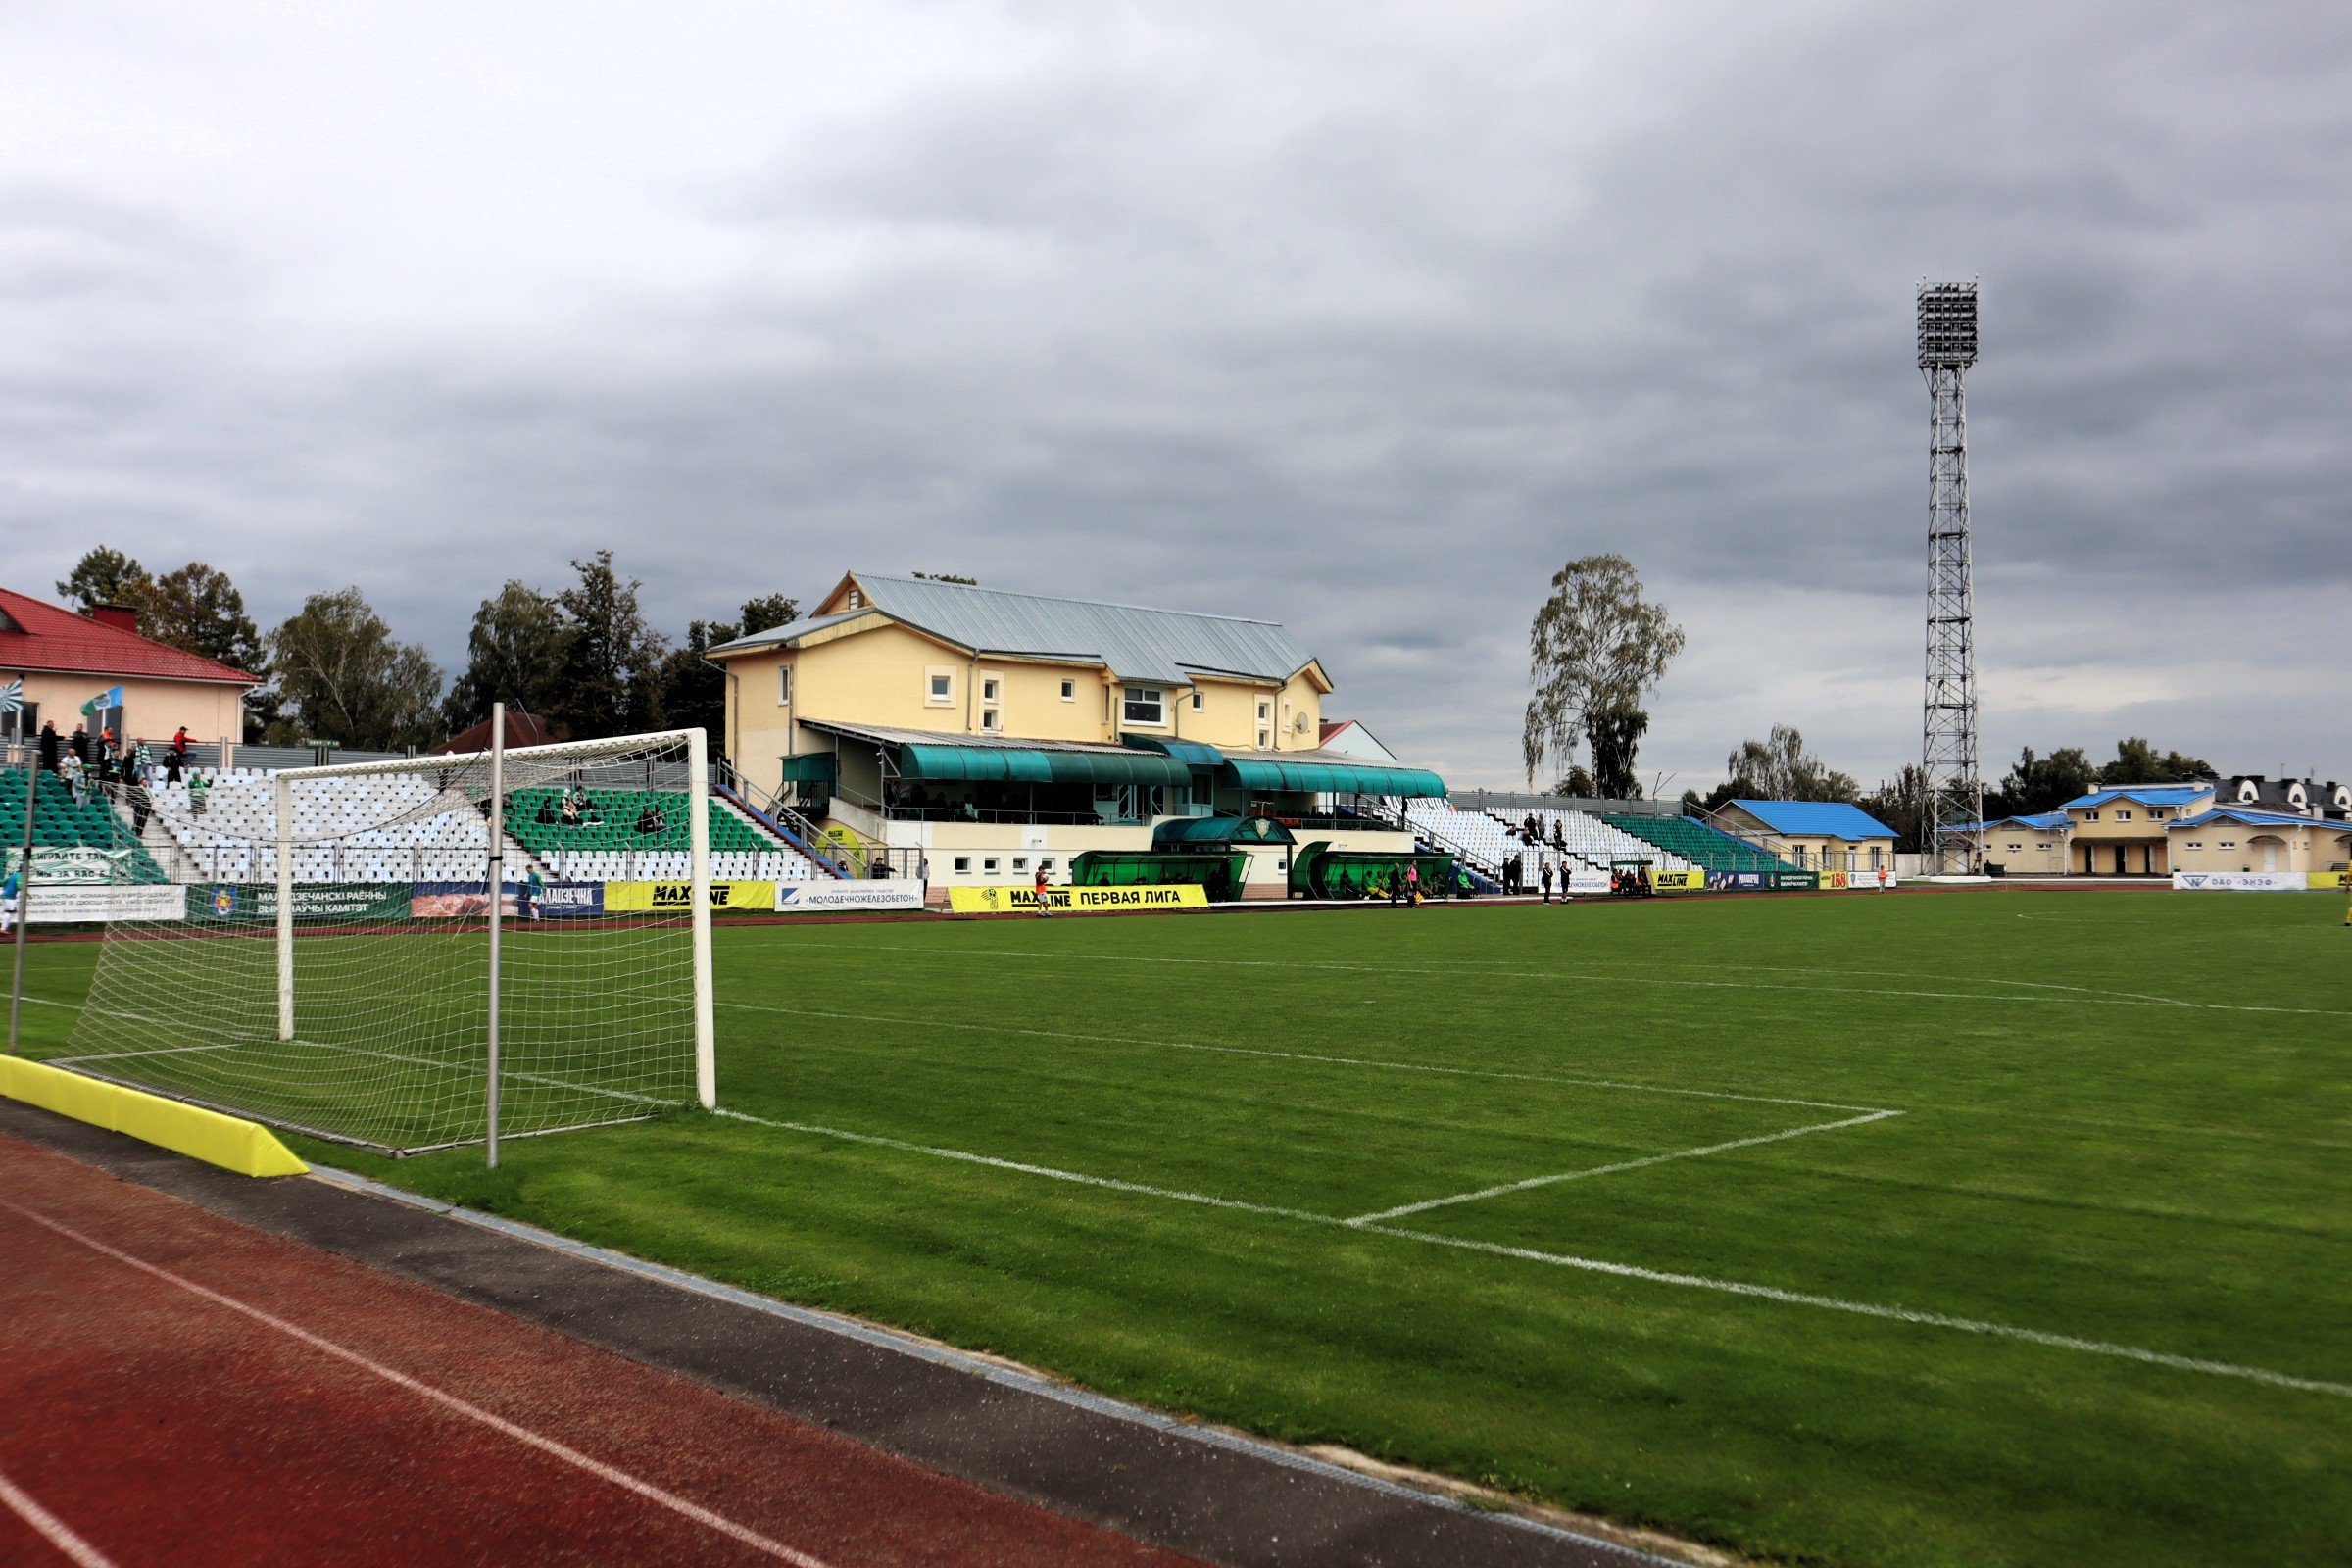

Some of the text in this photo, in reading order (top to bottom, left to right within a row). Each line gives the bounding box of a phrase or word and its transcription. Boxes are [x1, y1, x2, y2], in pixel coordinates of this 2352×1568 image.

[36, 852, 81, 860] ИГРАЙТЕ
[257, 891, 345, 902] МАЛДЗЕЧАНСКІ
[538, 887, 593, 906] АЛАДЗЕЧНА
[652, 885, 731, 906] MAXNE
[1010, 890, 1071, 907] MAXINE
[1080, 890, 1181, 905] ПЕРВАЯ ЛИГА
[257, 902, 324, 913] ВЫКНАЎЧЫ
